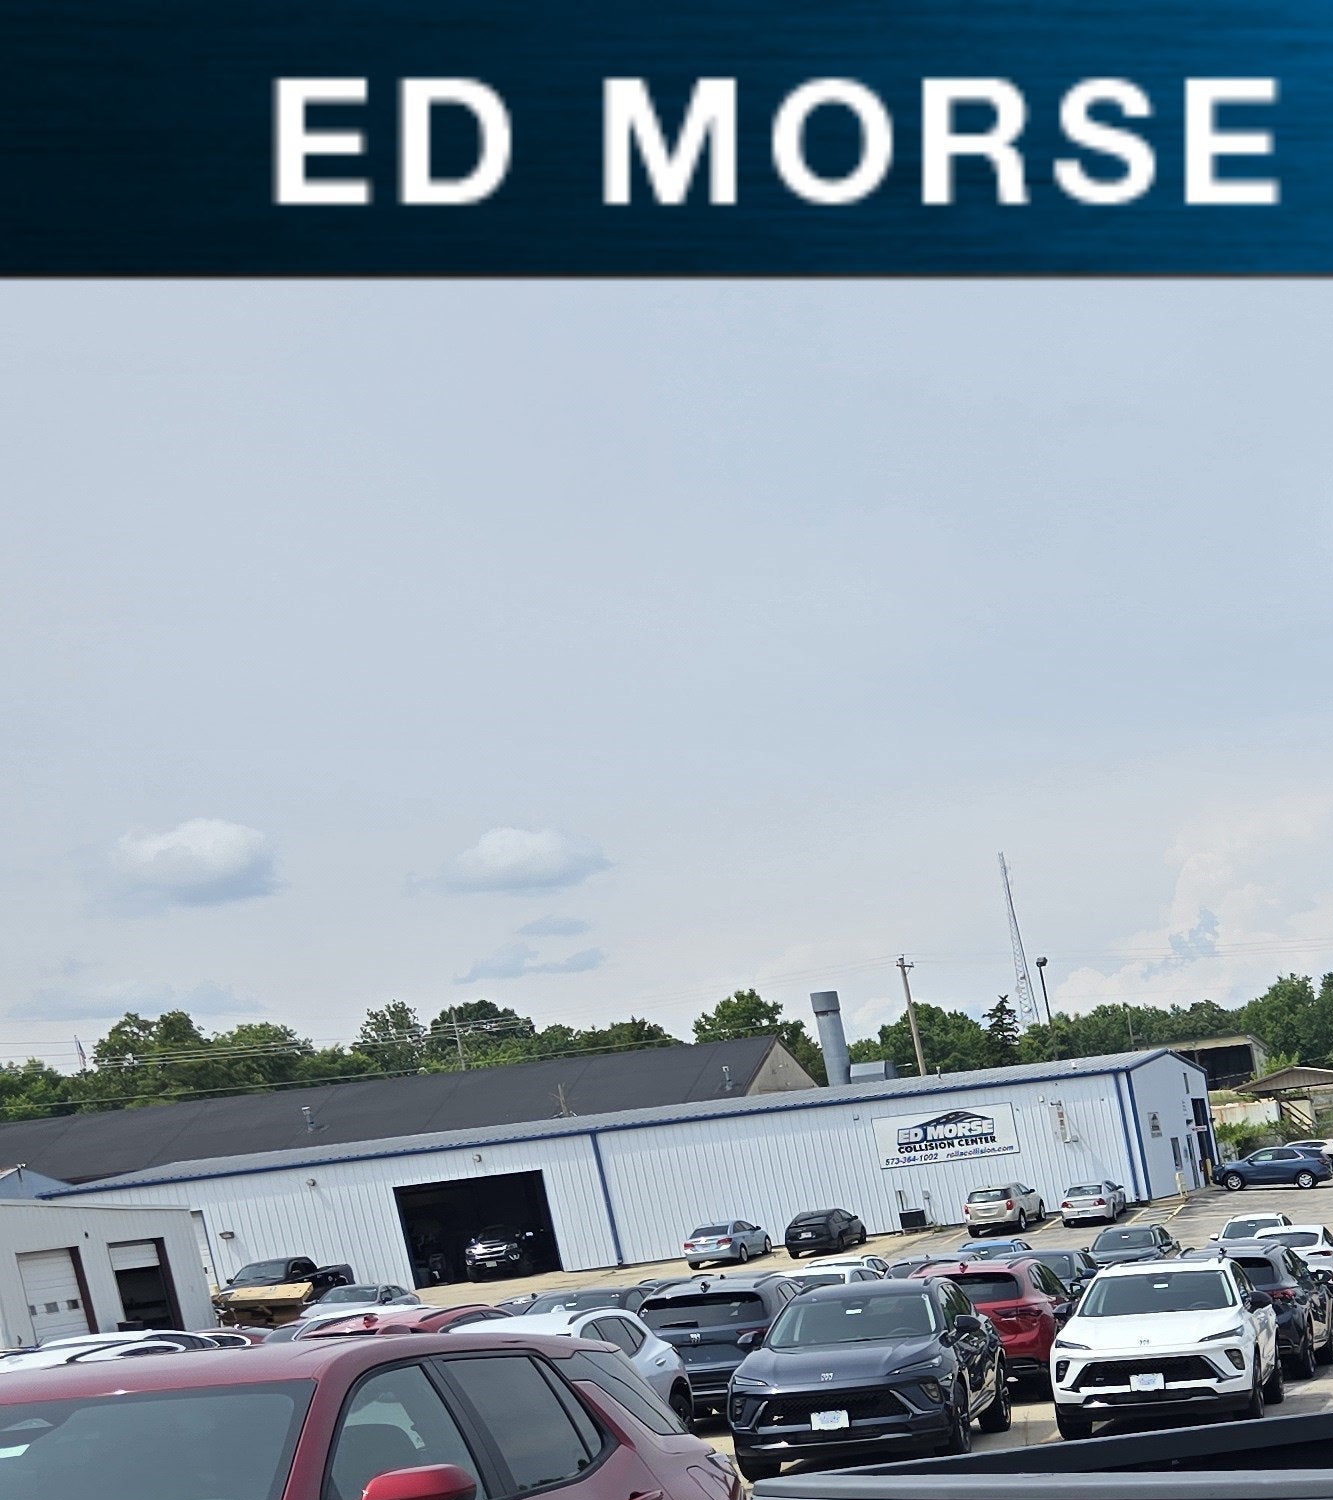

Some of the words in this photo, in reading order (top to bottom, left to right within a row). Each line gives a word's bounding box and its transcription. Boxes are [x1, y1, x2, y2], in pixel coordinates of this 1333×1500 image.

[898, 1128, 924, 1144] ED
[926, 1118, 994, 1141] MORSE
[897, 1139, 955, 1154] COLLISION
[957, 1135, 997, 1147] CENTER
[885, 1153, 939, 1166] 573-364-1002
